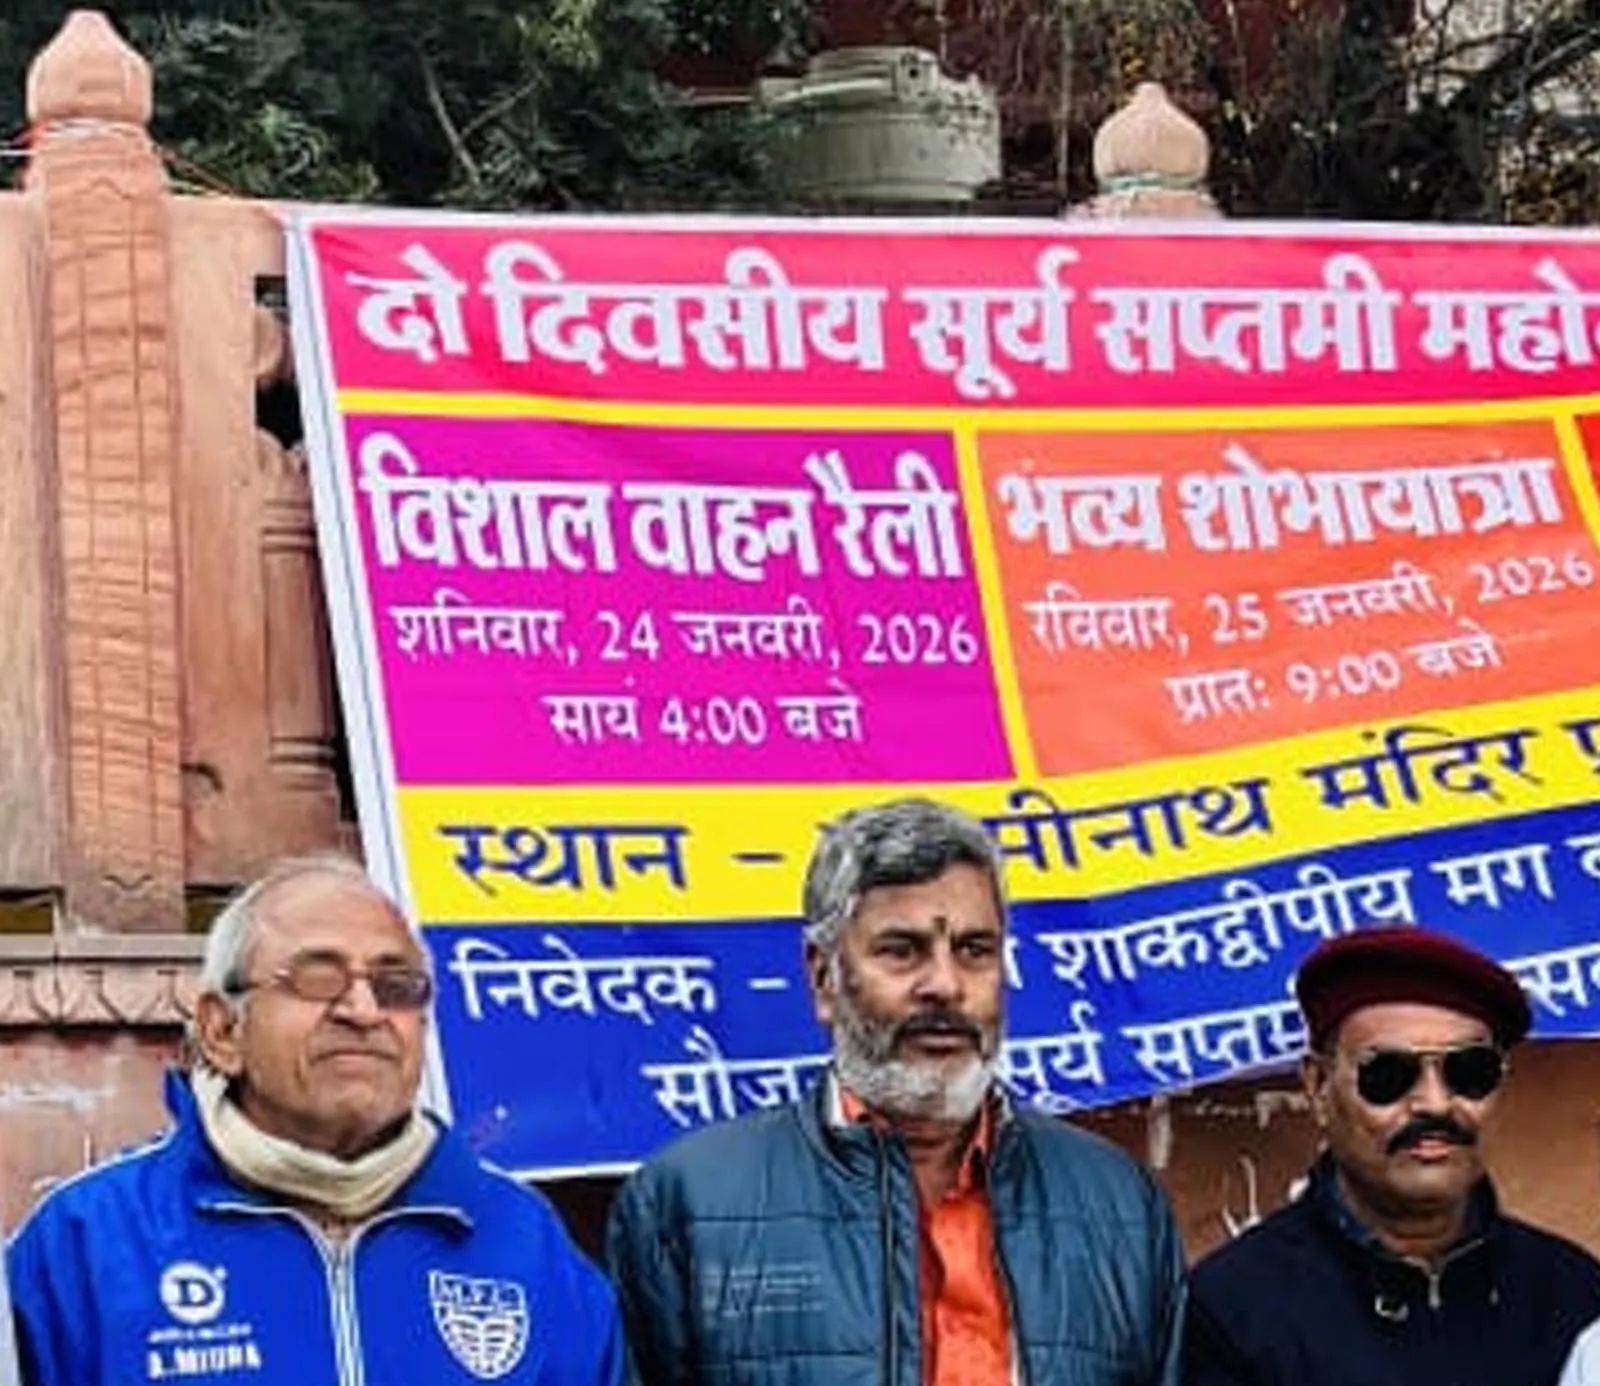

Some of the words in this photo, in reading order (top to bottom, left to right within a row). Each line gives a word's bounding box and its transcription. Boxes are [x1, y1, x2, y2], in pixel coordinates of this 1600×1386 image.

[345, 244, 470, 364] दो
[482, 241, 887, 376] दिवसीय
[904, 245, 1081, 398] सूर्य
[1090, 253, 1402, 375] सप्तमी
[358, 432, 616, 573] विशाल
[623, 478, 822, 582] वाहन
[804, 449, 967, 579] रैली
[996, 472, 1167, 554] भव्य
[1176, 446, 1565, 551] शोभायात्रा
[388, 591, 580, 666] शनिवार,
[598, 610, 661, 662] 24
[671, 596, 842, 667] जनवरी,
[858, 614, 979, 664] 2026
[1023, 580, 1189, 655] रविवार,
[1209, 593, 1270, 643] 25
[1275, 561, 1455, 633] जनवरी,
[1472, 553, 1595, 603] 2026
[658, 697, 769, 746] 4:00
[775, 677, 863, 745] बजे
[1285, 650, 1402, 703] 9:00
[1401, 616, 1501, 677] बजे
[437, 823, 691, 897] स्थान
[1303, 723, 1543, 809] मंदिर
[1034, 862, 1416, 989] शाकद्वीपीय
[1431, 843, 1553, 907] मग
[448, 934, 718, 1028] निवेदक
